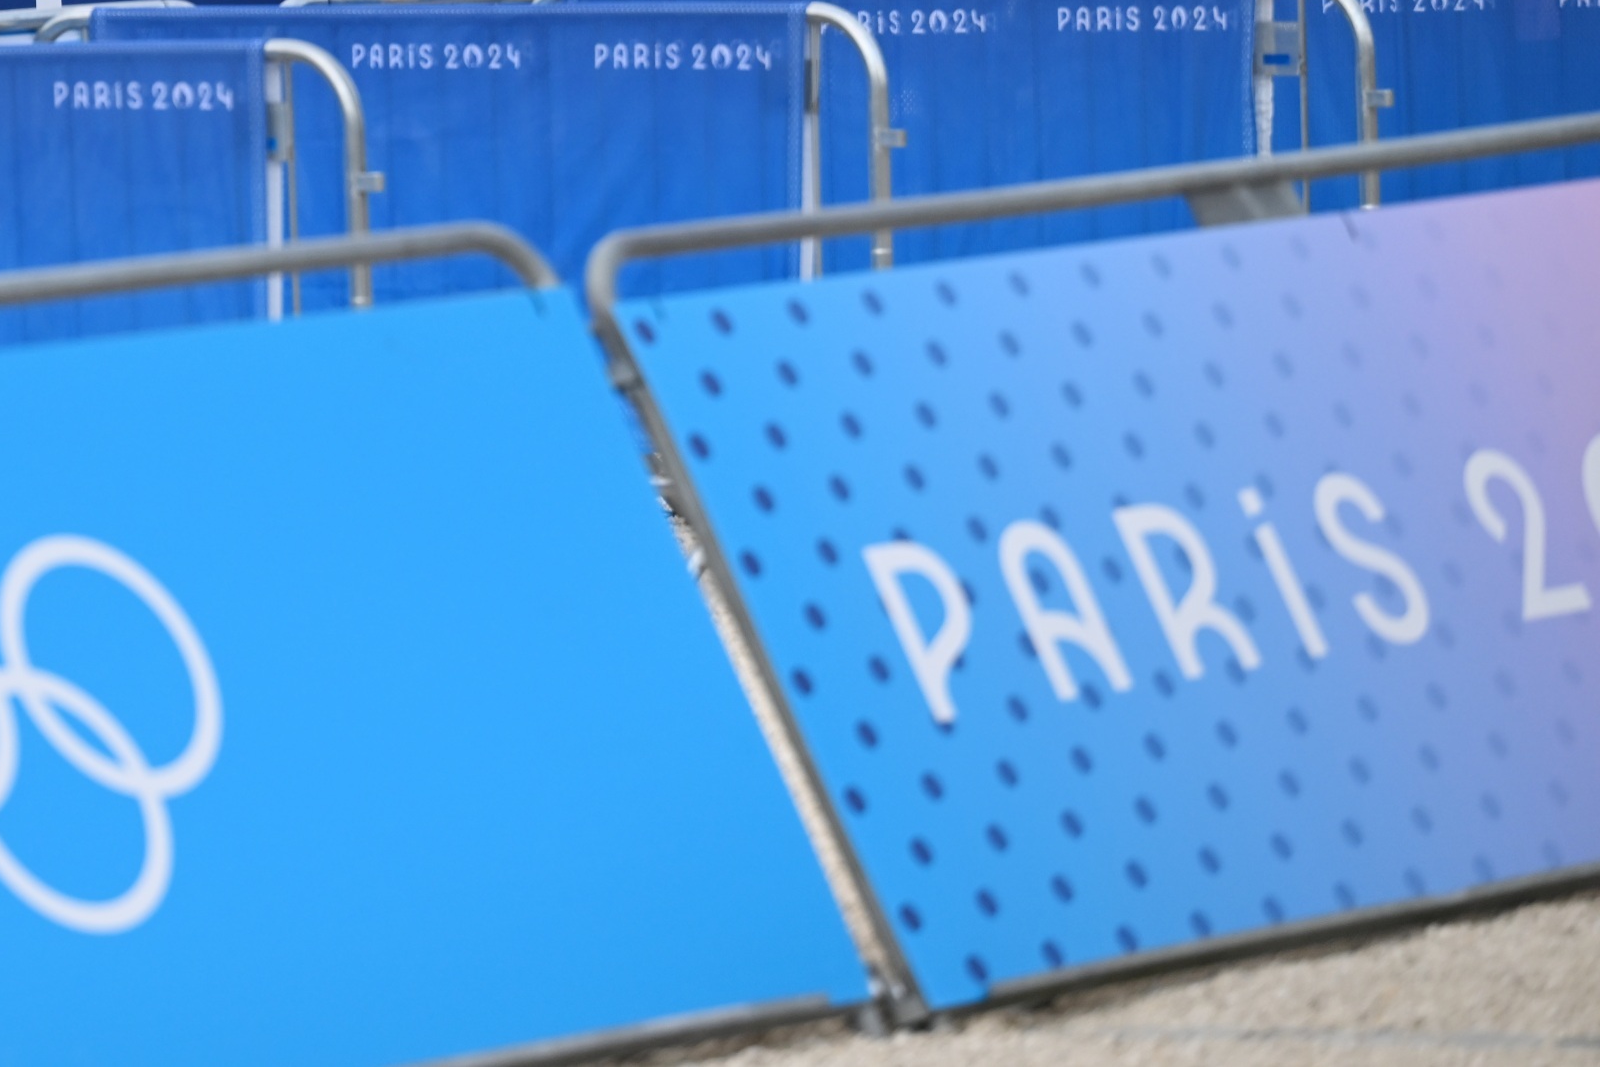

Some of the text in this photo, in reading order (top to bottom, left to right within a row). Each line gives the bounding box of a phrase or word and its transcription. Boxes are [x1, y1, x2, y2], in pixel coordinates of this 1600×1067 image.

[911, 9, 987, 34] 2024
[1153, 5, 1229, 31] 2024
[444, 42, 522, 70] 2024
[691, 43, 772, 71] 2024
[151, 81, 234, 111] 2024
